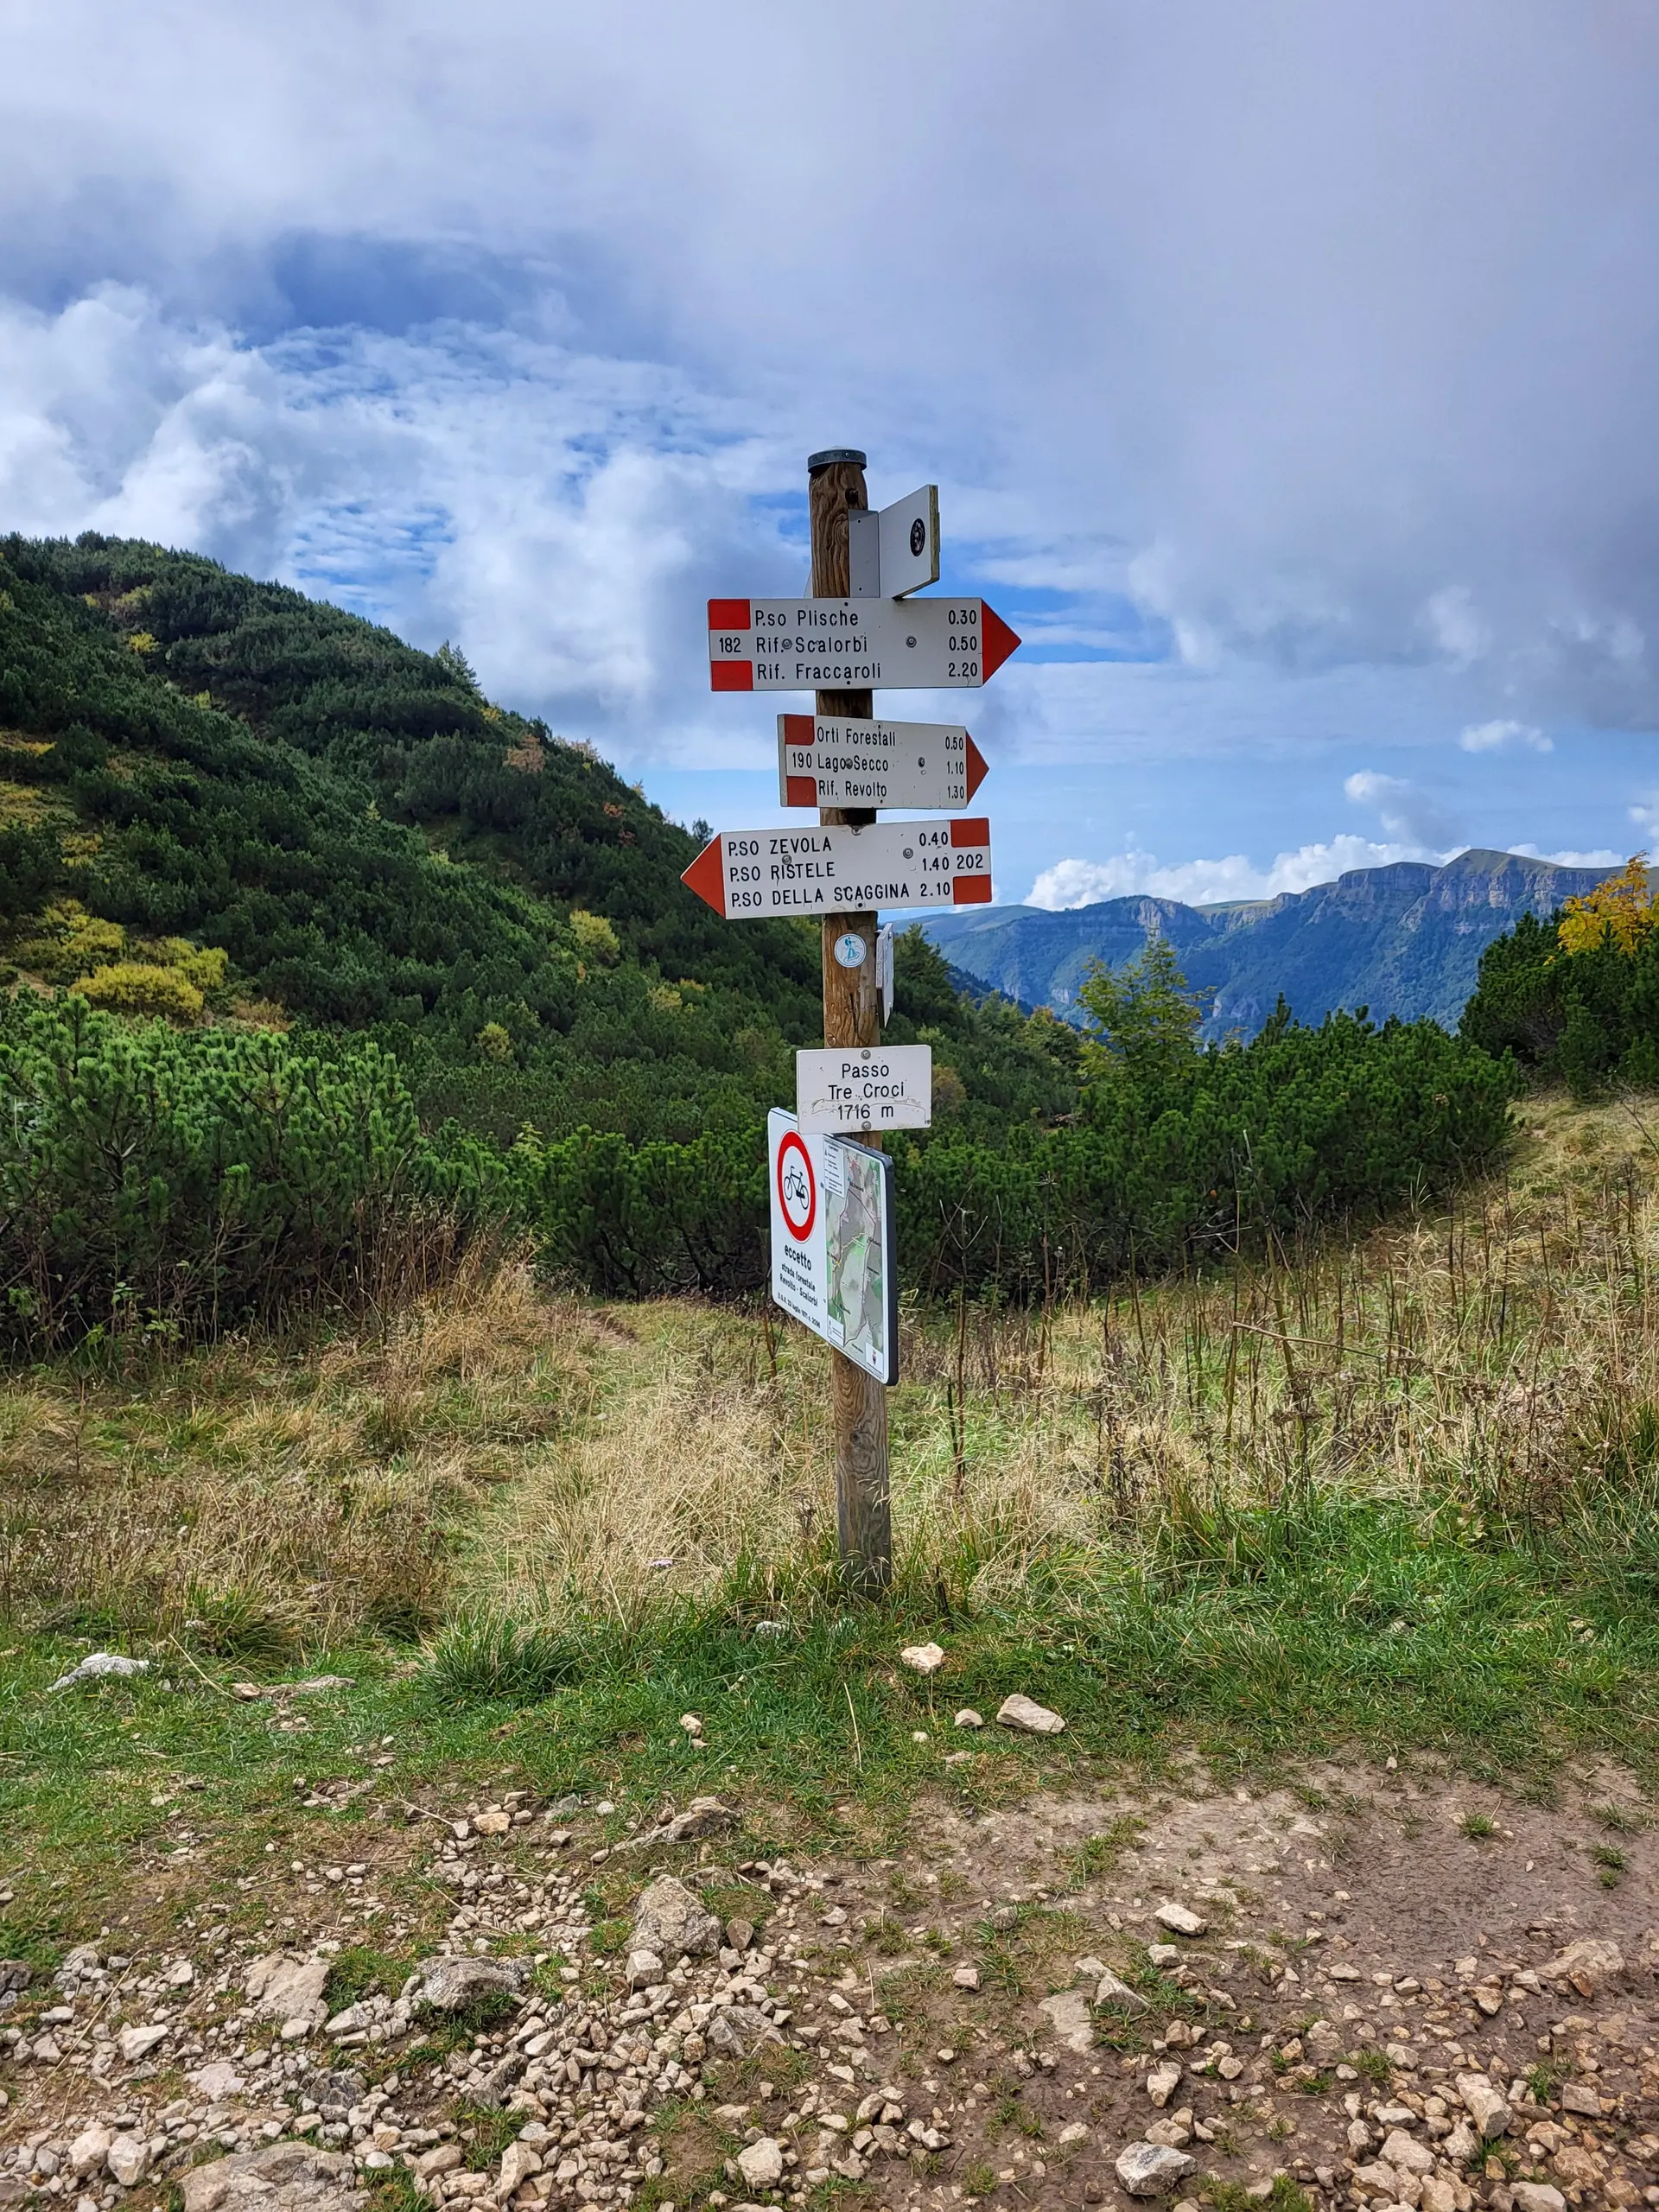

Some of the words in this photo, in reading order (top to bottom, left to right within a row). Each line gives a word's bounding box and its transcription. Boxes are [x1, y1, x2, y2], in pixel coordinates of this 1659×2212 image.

[755, 609, 787, 627] P.so
[797, 609, 859, 627] Plische
[948, 608, 977, 626] 0.30
[719, 637, 742, 653] 182
[755, 636, 785, 654] Rif.
[795, 636, 868, 654] Scalorbi
[949, 634, 977, 652] 0.50
[756, 663, 785, 681] Rif.
[795, 662, 881, 679] Fraccaroli
[948, 661, 978, 678] 2.20
[817, 727, 839, 744] Orti
[846, 728, 896, 747] Forestali
[944, 736, 964, 751] 0.50
[791, 752, 812, 769] 190
[817, 753, 846, 773] Lago
[854, 754, 889, 772] Secco
[946, 761, 964, 776] 1.10
[818, 779, 839, 797] Rif.
[844, 781, 887, 798] Revolto
[947, 785, 965, 800] 1.30
[728, 840, 760, 857] P.SO
[769, 836, 832, 855] ZEVOLA
[918, 831, 949, 848] 0.40
[729, 866, 761, 882] P.SO
[771, 861, 836, 880] RISTELE
[922, 857, 950, 872] 1.40
[957, 854, 984, 870] 202
[731, 891, 763, 908] P.SO
[772, 887, 823, 906] DELLA
[834, 881, 910, 902] SCAGGINA
[920, 881, 950, 897] 2.10
[842, 1063, 889, 1079] Passo
[828, 1084, 853, 1100] Tre
[863, 1082, 904, 1098] Croci
[837, 1104, 871, 1121] 1716
[880, 1104, 894, 1118] m
[784, 1244, 812, 1271] eccetto
[781, 1263, 795, 1278] strada
[795, 1271, 816, 1293] forestale
[779, 1273, 797, 1292] Revolto
[799, 1287, 818, 1307] Scalorbi
